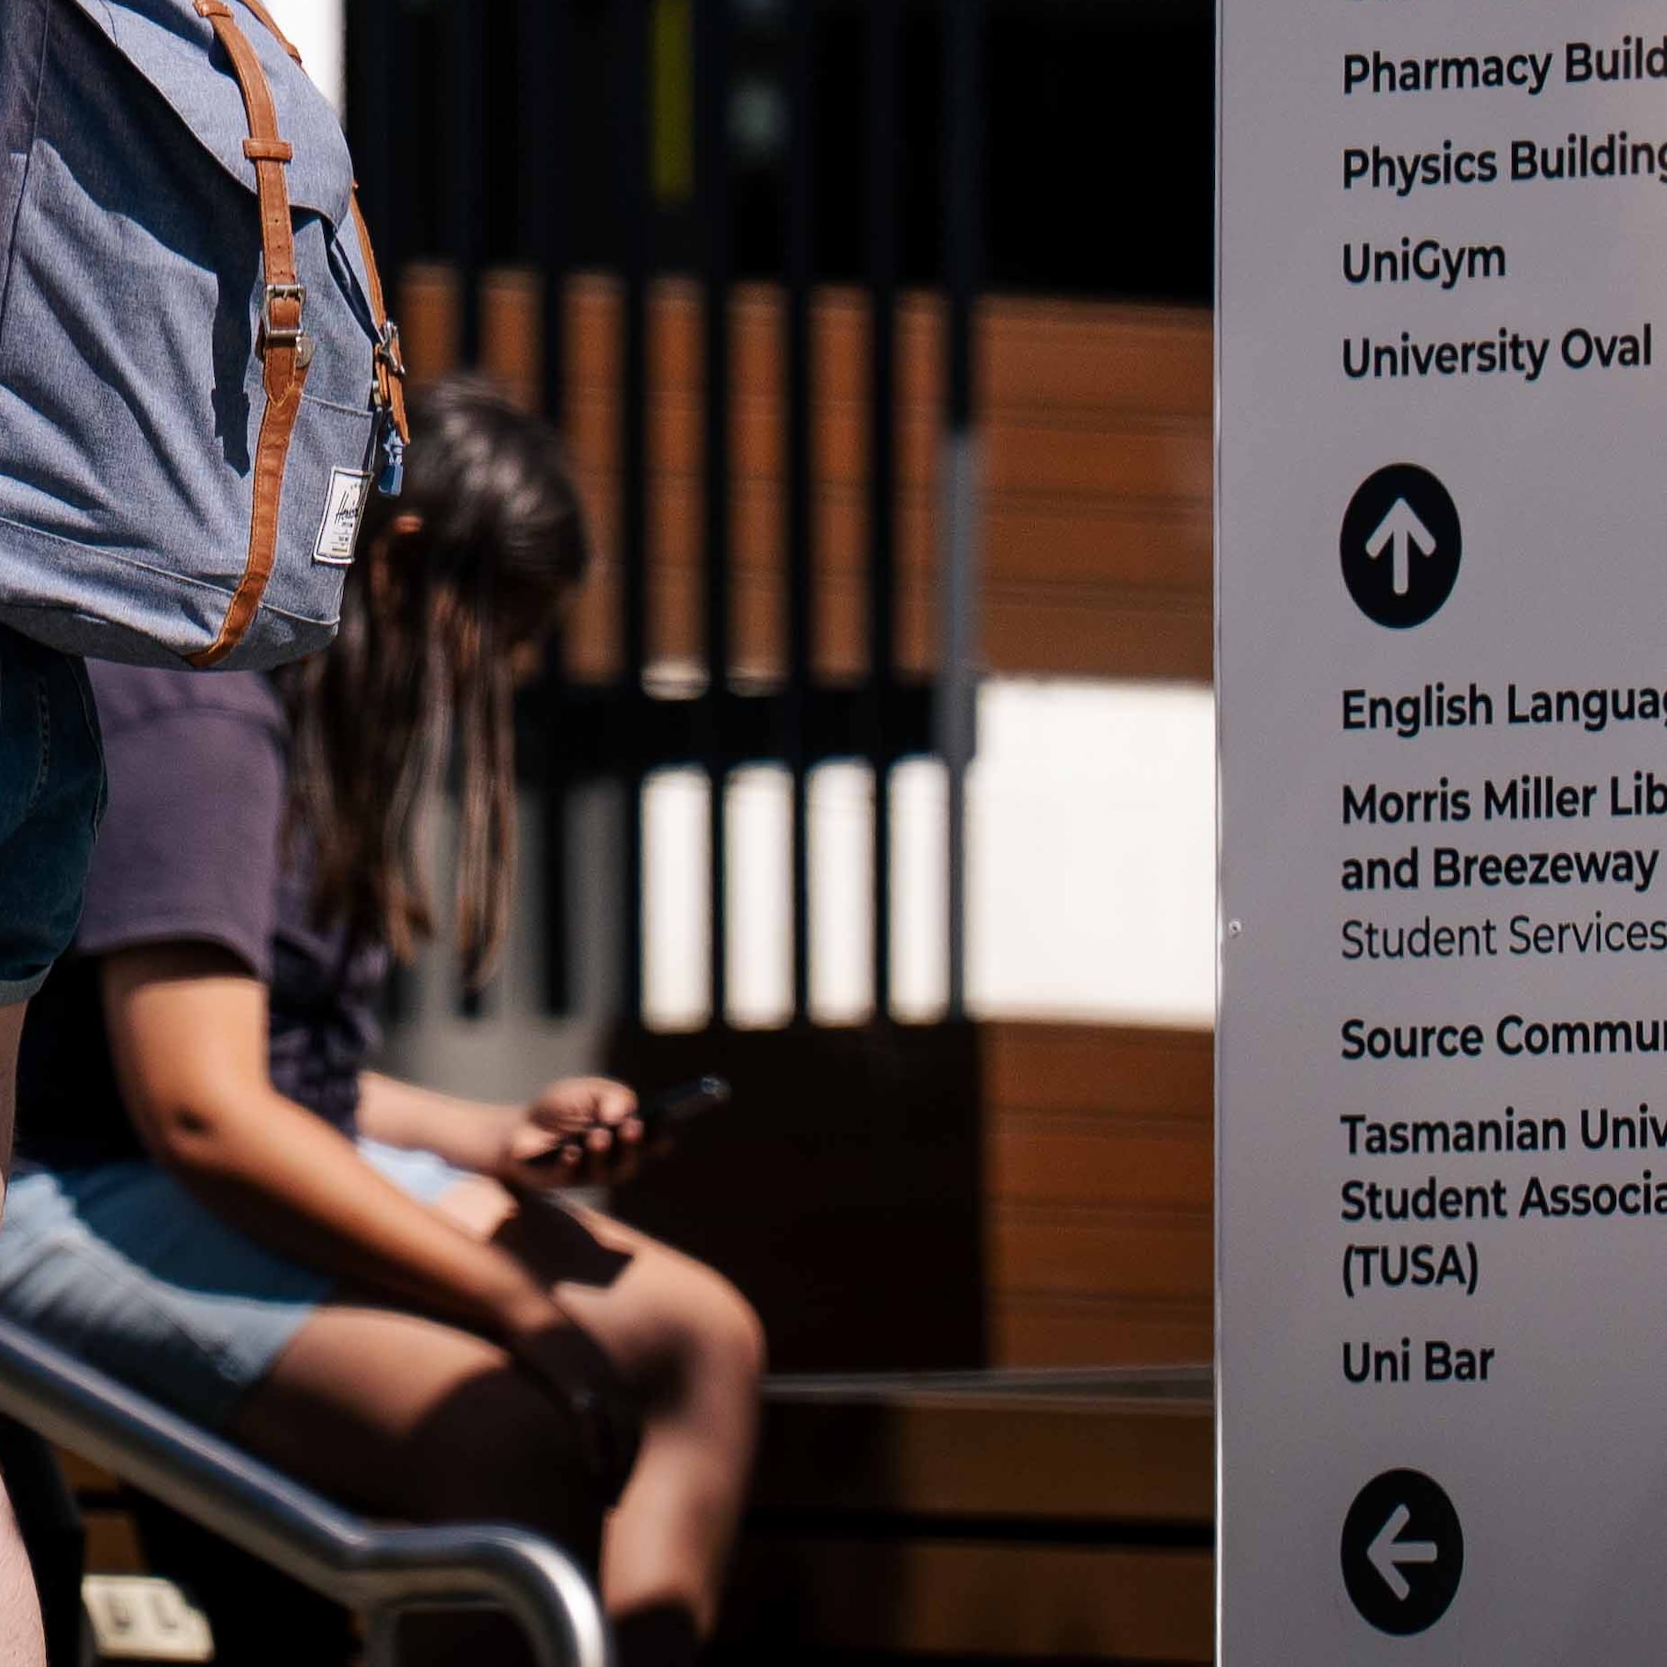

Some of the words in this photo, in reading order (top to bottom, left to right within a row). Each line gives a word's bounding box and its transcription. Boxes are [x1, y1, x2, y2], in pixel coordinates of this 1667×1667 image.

[1343, 50, 1554, 96] Pharmacy
[1565, 34, 1667, 84] Build
[1343, 139, 1498, 198] Physics
[1342, 236, 1506, 291] UniGym
[1342, 326, 1551, 383] University
[1560, 322, 1652, 370] Oval
[1341, 681, 1494, 740] English
[1507, 683, 1667, 733] Langua
[1342, 775, 1472, 826] Morris
[1483, 773, 1598, 822] Miller
[1610, 769, 1667, 817] Lib
[1340, 845, 1419, 892] and
[1433, 846, 1660, 894] Breezeway
[1341, 914, 1498, 961] Student
[1509, 909, 1667, 956] Services
[1340, 1018, 1485, 1061] Source
[1495, 1013, 1667, 1057] Commu
[1339, 1105, 1567, 1156] Tasmanian
[1580, 1102, 1667, 1151] Univ
[1340, 1175, 1509, 1223] Student
[1518, 1168, 1667, 1219] Associa
[1342, 1240, 1479, 1299] (TUSA)
[1342, 1336, 1411, 1384] Uni
[1424, 1340, 1496, 1383] Bar
